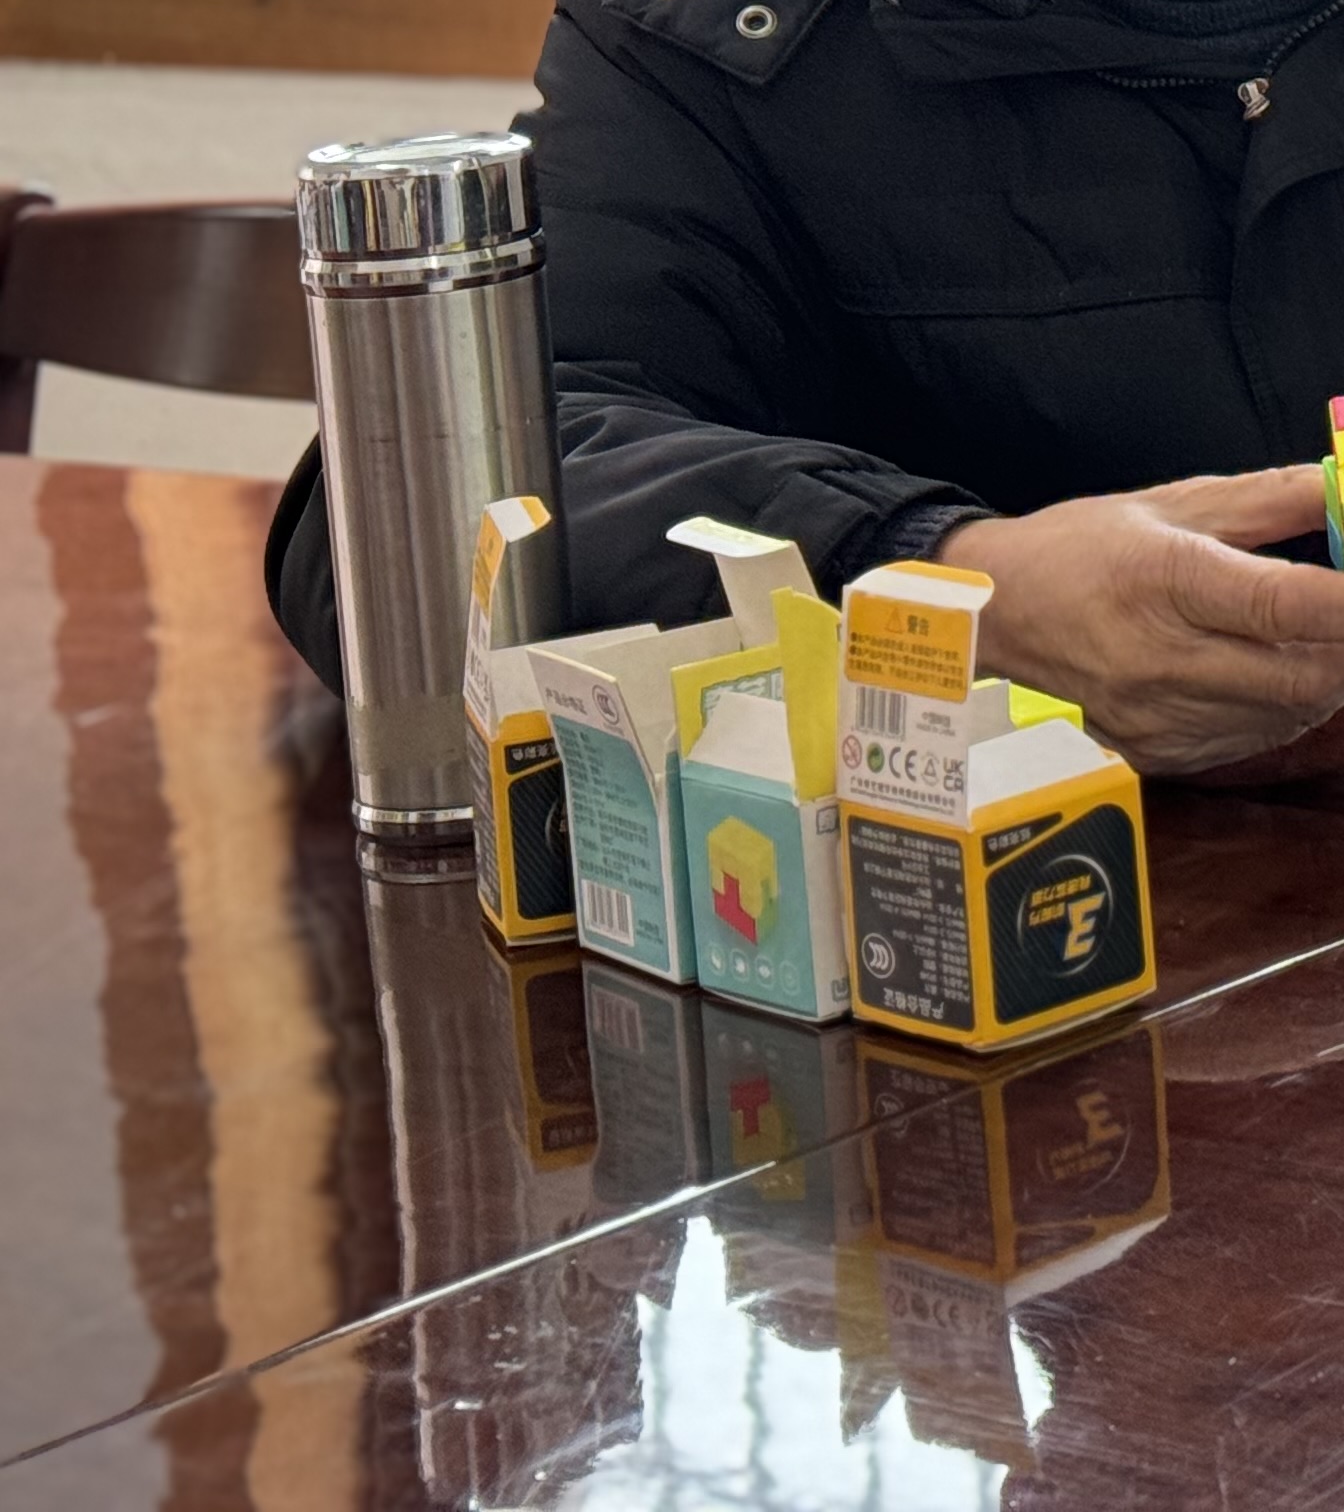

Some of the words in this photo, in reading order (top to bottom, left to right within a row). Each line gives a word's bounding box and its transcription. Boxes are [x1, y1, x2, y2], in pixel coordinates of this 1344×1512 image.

[888, 746, 917, 782] CE
[882, 987, 945, 1020] 产品合格证
